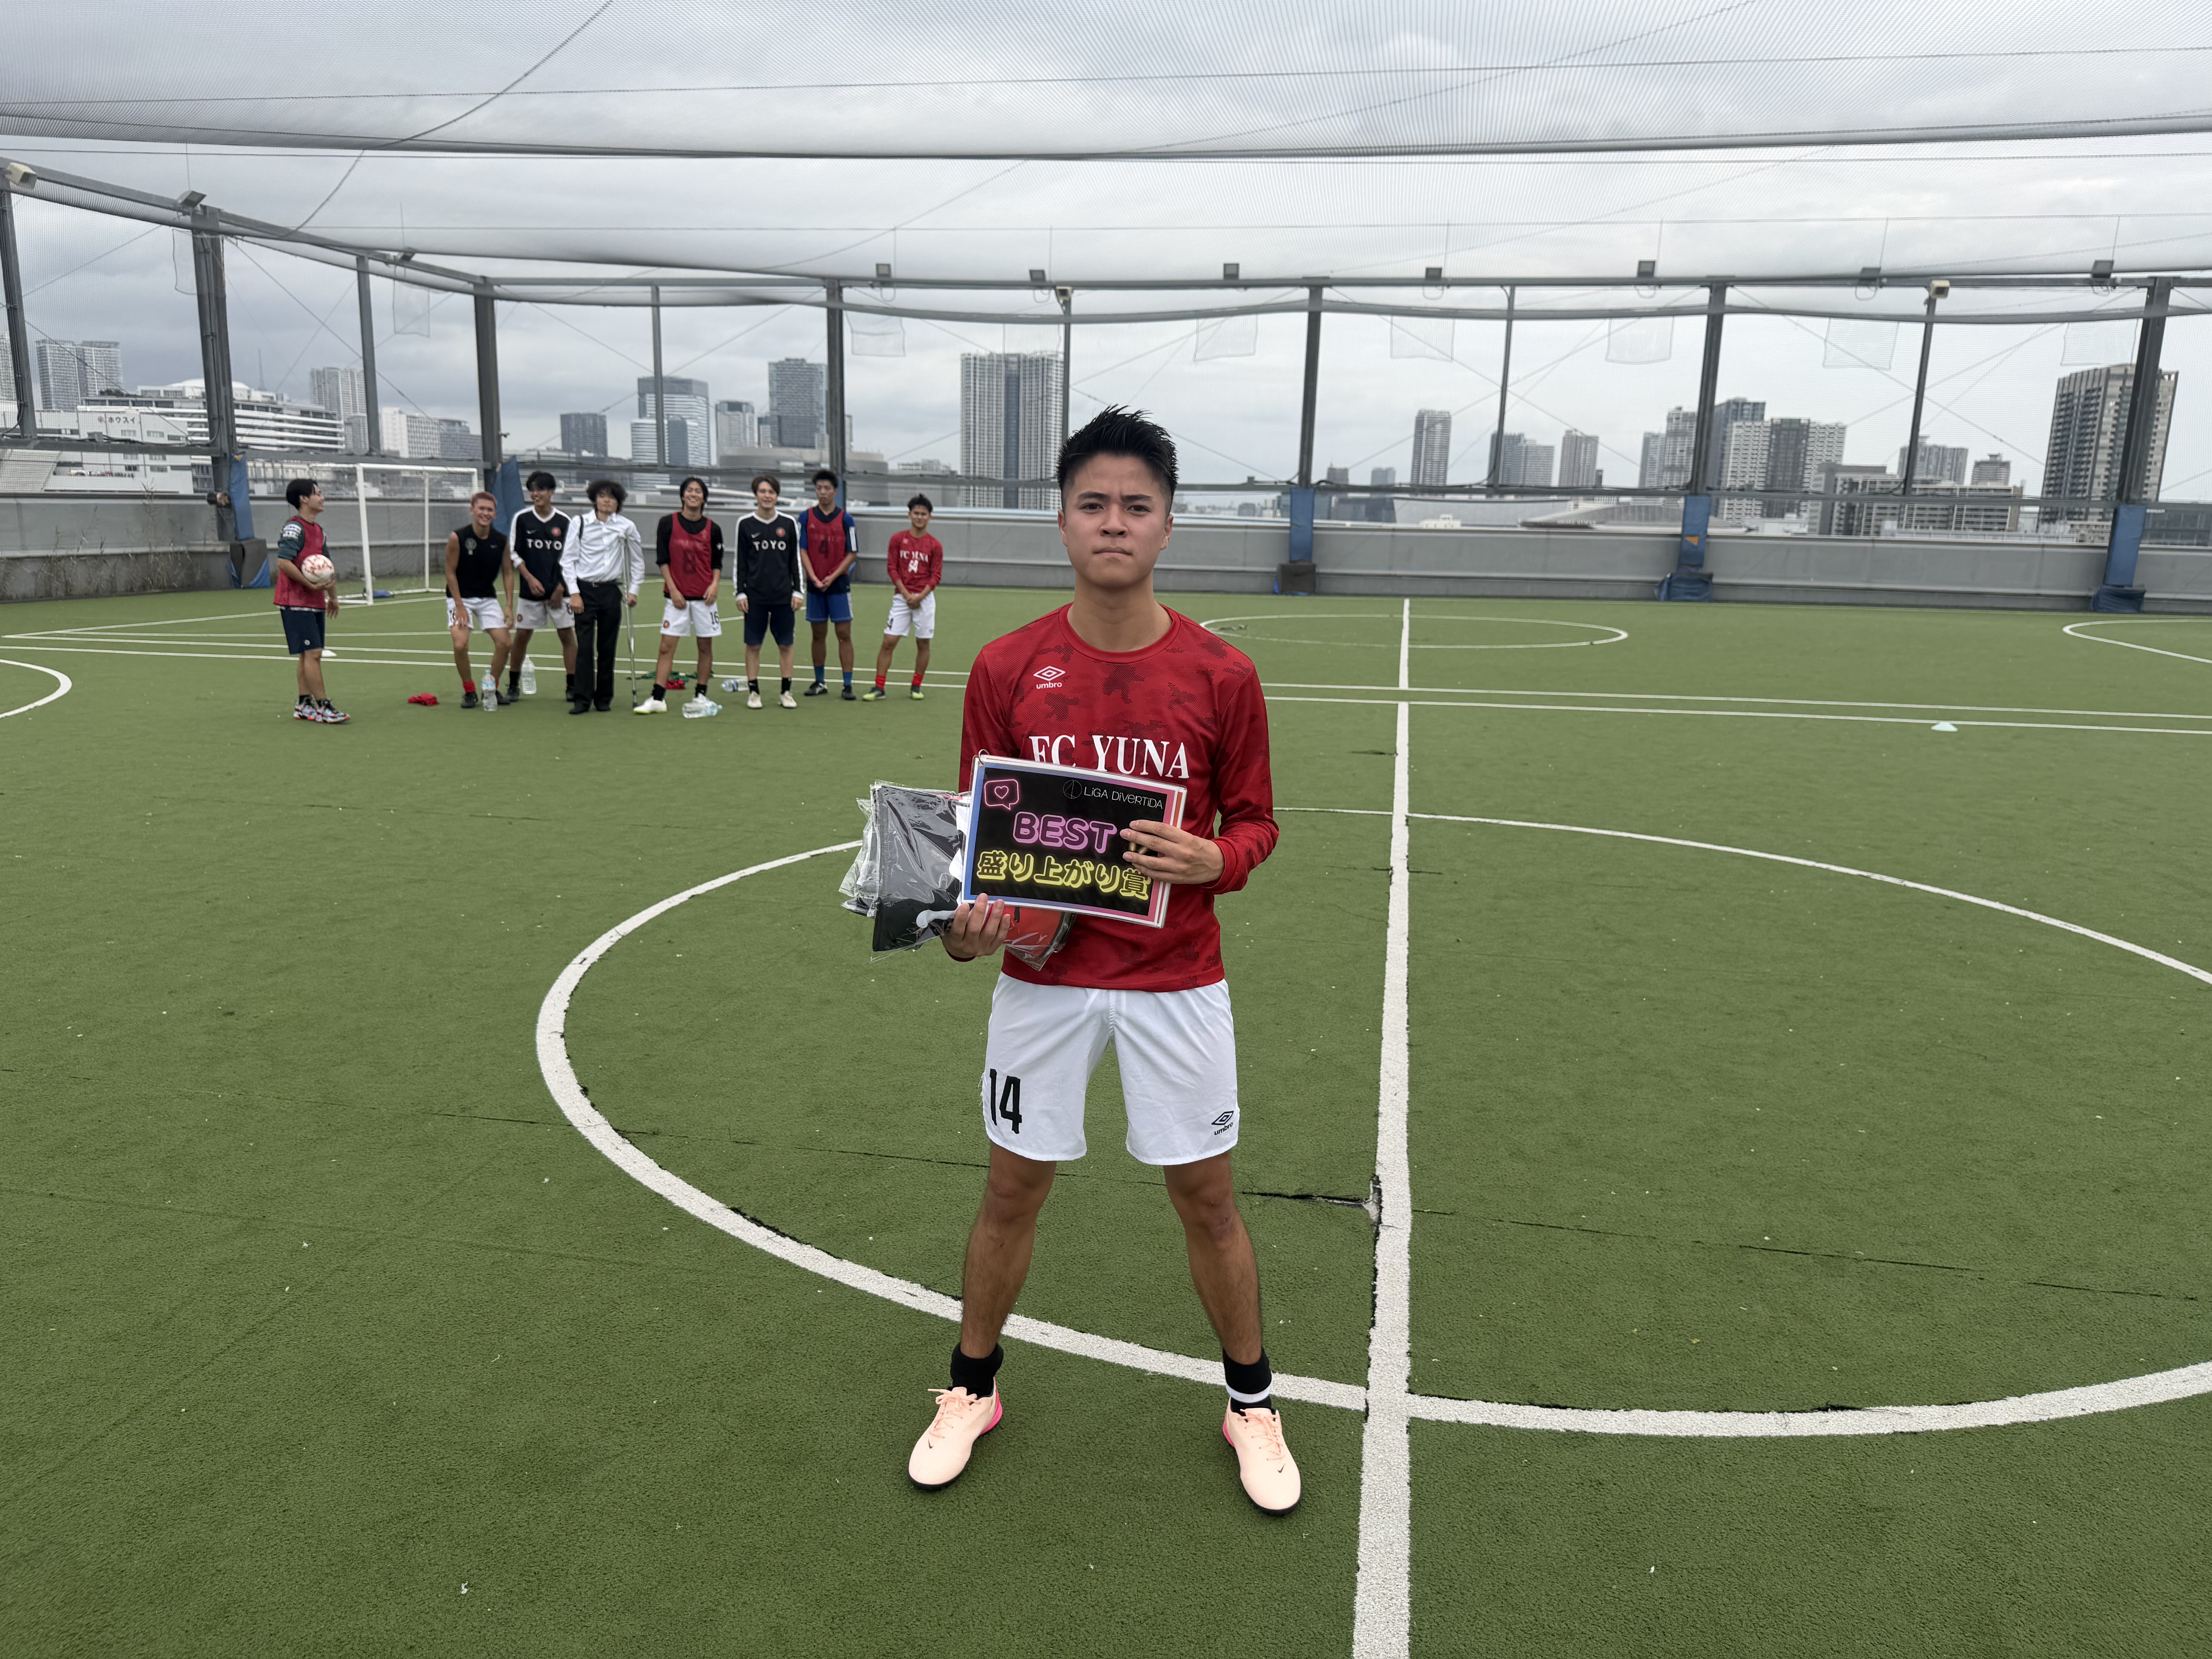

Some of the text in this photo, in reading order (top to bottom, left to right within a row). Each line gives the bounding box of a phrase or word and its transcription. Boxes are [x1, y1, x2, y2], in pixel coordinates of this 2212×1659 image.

[526, 538, 562, 550] TOYO
[752, 539, 787, 551] TOYO
[710, 611, 719, 624] 16
[1029, 735, 1189, 779] FC YUNA
[1013, 811, 1117, 854] BEST
[977, 850, 1151, 900] 盛り上がり賞
[989, 1068, 1022, 1134] 14
[1214, 1122, 1233, 1135] umbro
